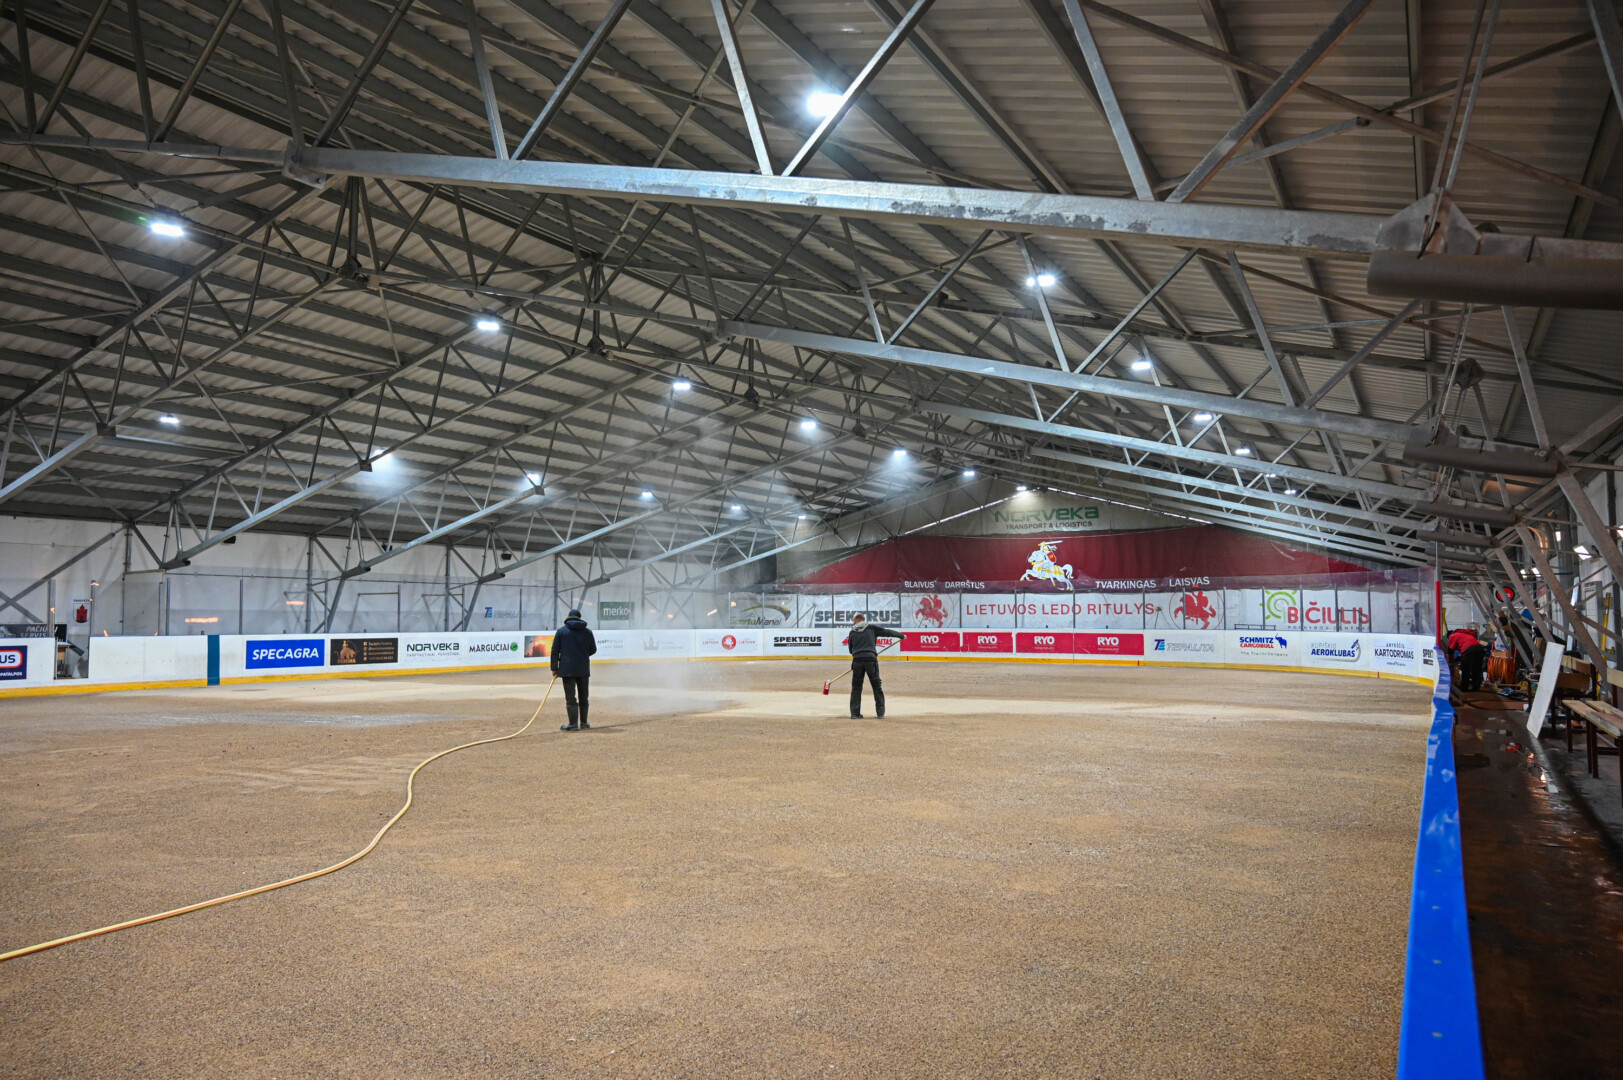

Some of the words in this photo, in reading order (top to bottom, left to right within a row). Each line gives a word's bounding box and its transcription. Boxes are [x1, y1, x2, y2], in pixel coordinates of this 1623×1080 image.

[945, 580, 985, 589] DARBŠTUS
[1095, 580, 1157, 589] TVARKINGAS
[1169, 576, 1210, 587] LAISVAS
[603, 606, 629, 616] merko
[966, 604, 1037, 615] LIETUVOS
[1042, 604, 1082, 615] LEDO
[1087, 603, 1155, 615] RITULYS
[1287, 601, 1370, 624] BČIULIS
[920, 635, 939, 644] RYO
[978, 635, 998, 644] RYO
[1034, 636, 1055, 645] RYO
[1097, 636, 1119, 646] RYO
[469, 641, 510, 653] MARGUČIAI
[1167, 643, 1215, 652] TEPALITA
[252, 647, 319, 660] SPECAGRA
[1311, 648, 1355, 658] AEROKLUBAS
[1374, 648, 1414, 660] KARTODROMAS
